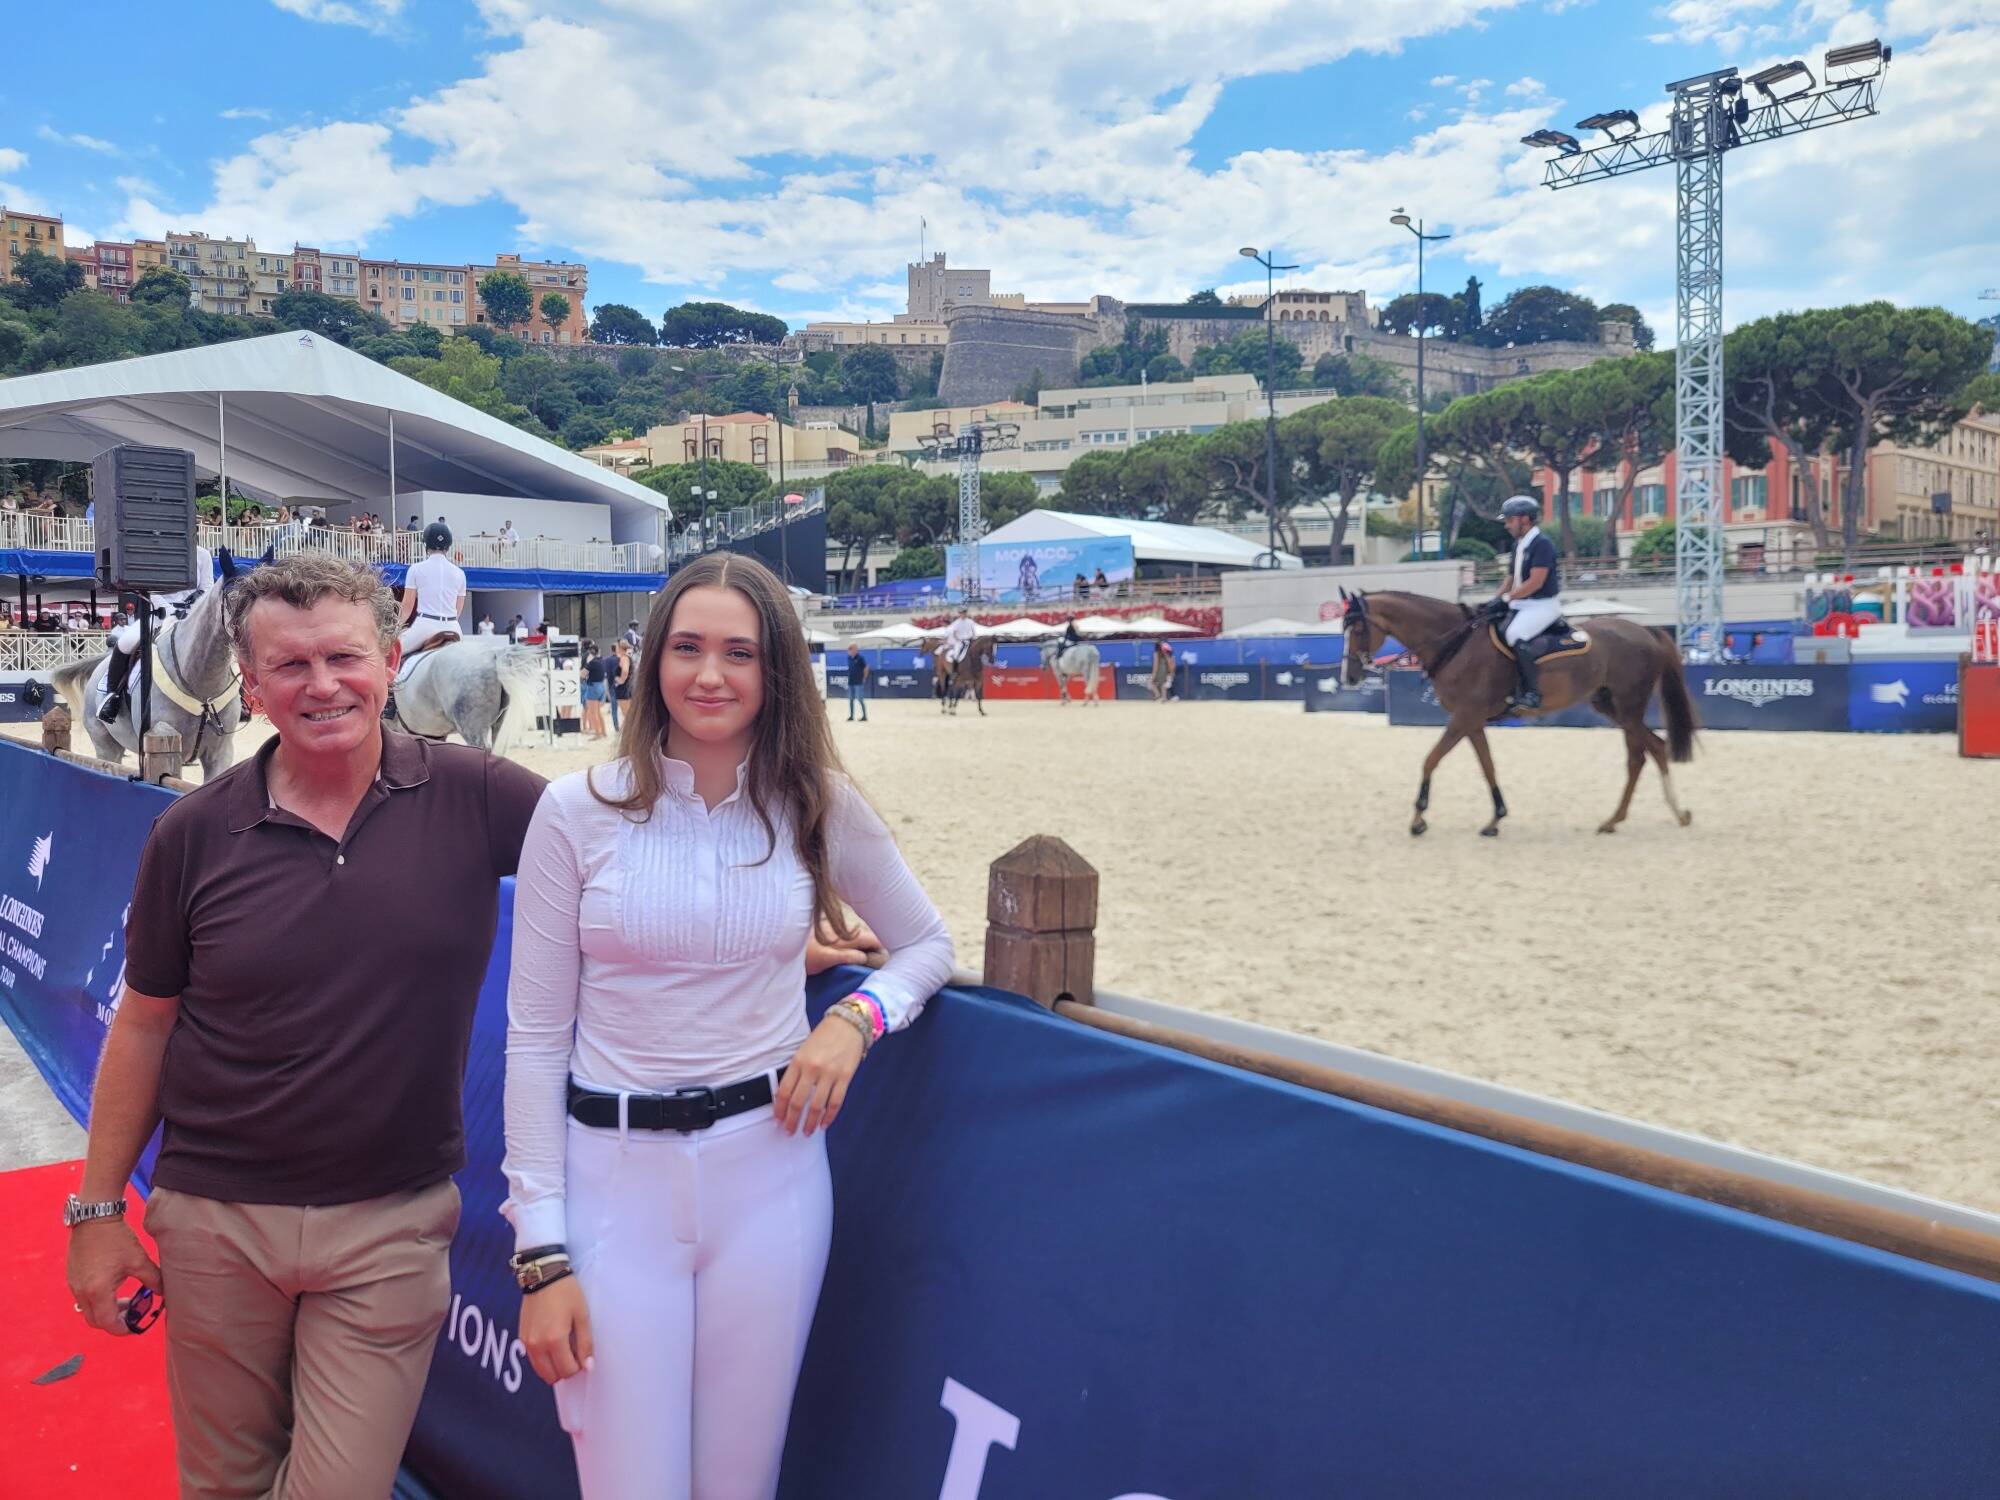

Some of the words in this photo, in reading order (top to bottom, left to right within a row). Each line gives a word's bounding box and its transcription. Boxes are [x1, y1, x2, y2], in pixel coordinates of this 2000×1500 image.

[1703, 678, 1814, 696] LONGINES
[0, 894, 45, 939] LONGINES
[7, 936, 47, 981] CHAMPIONS
[0, 965, 16, 989] TOUR
